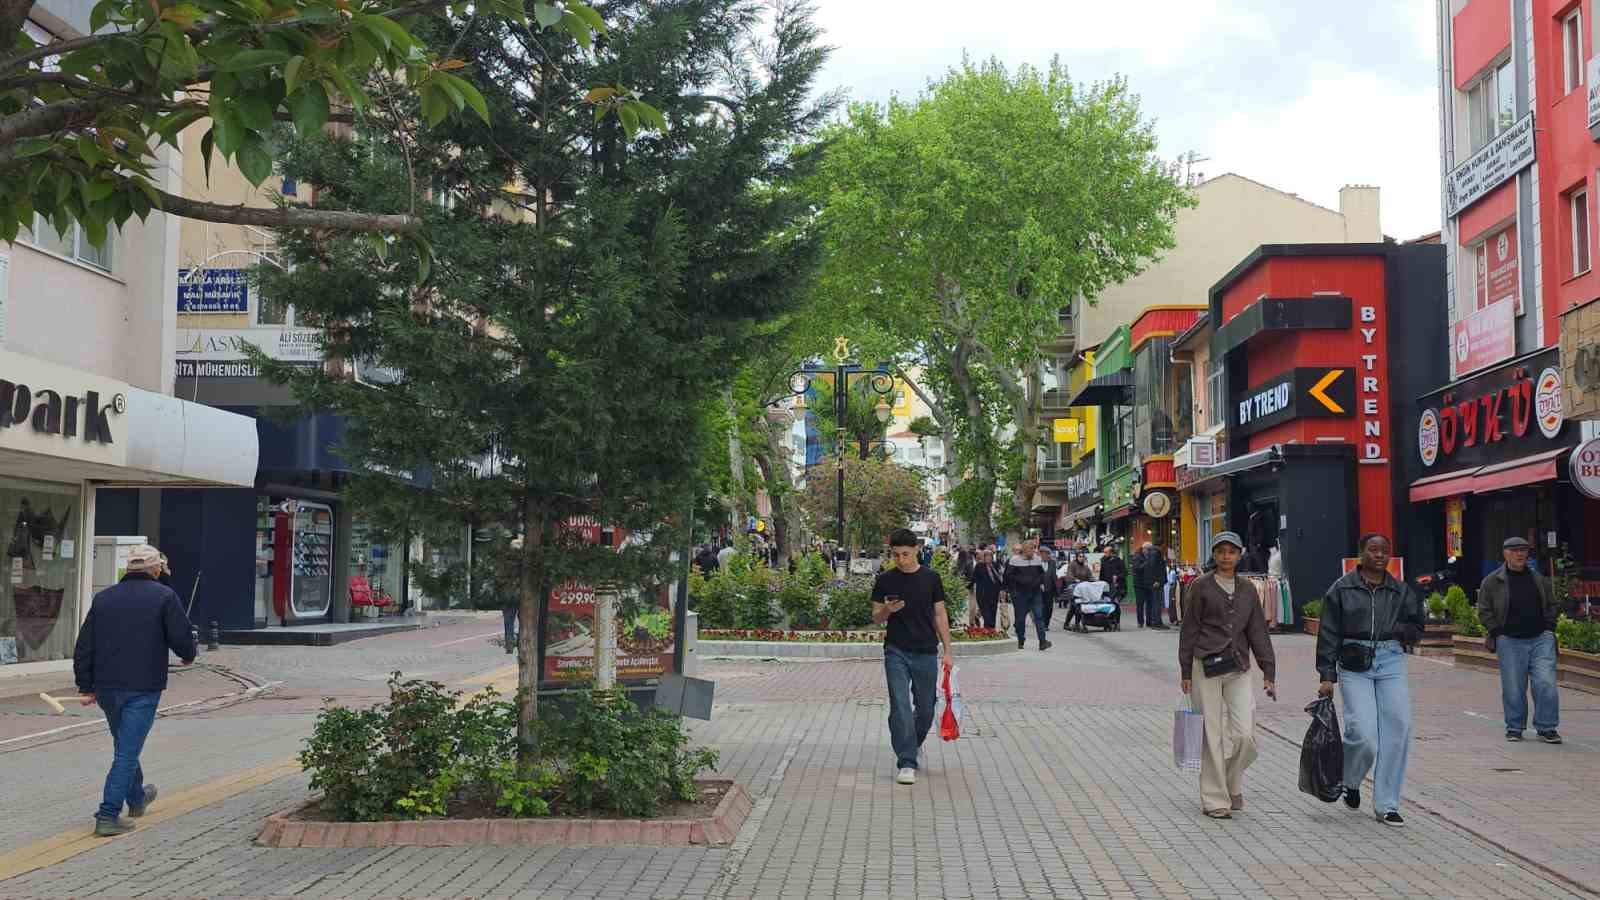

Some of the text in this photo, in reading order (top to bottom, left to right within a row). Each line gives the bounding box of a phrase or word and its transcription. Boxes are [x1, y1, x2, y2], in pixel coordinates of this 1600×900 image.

[1239, 382, 1290, 425] BY TREND
[1360, 306, 1381, 459] BY TREND
